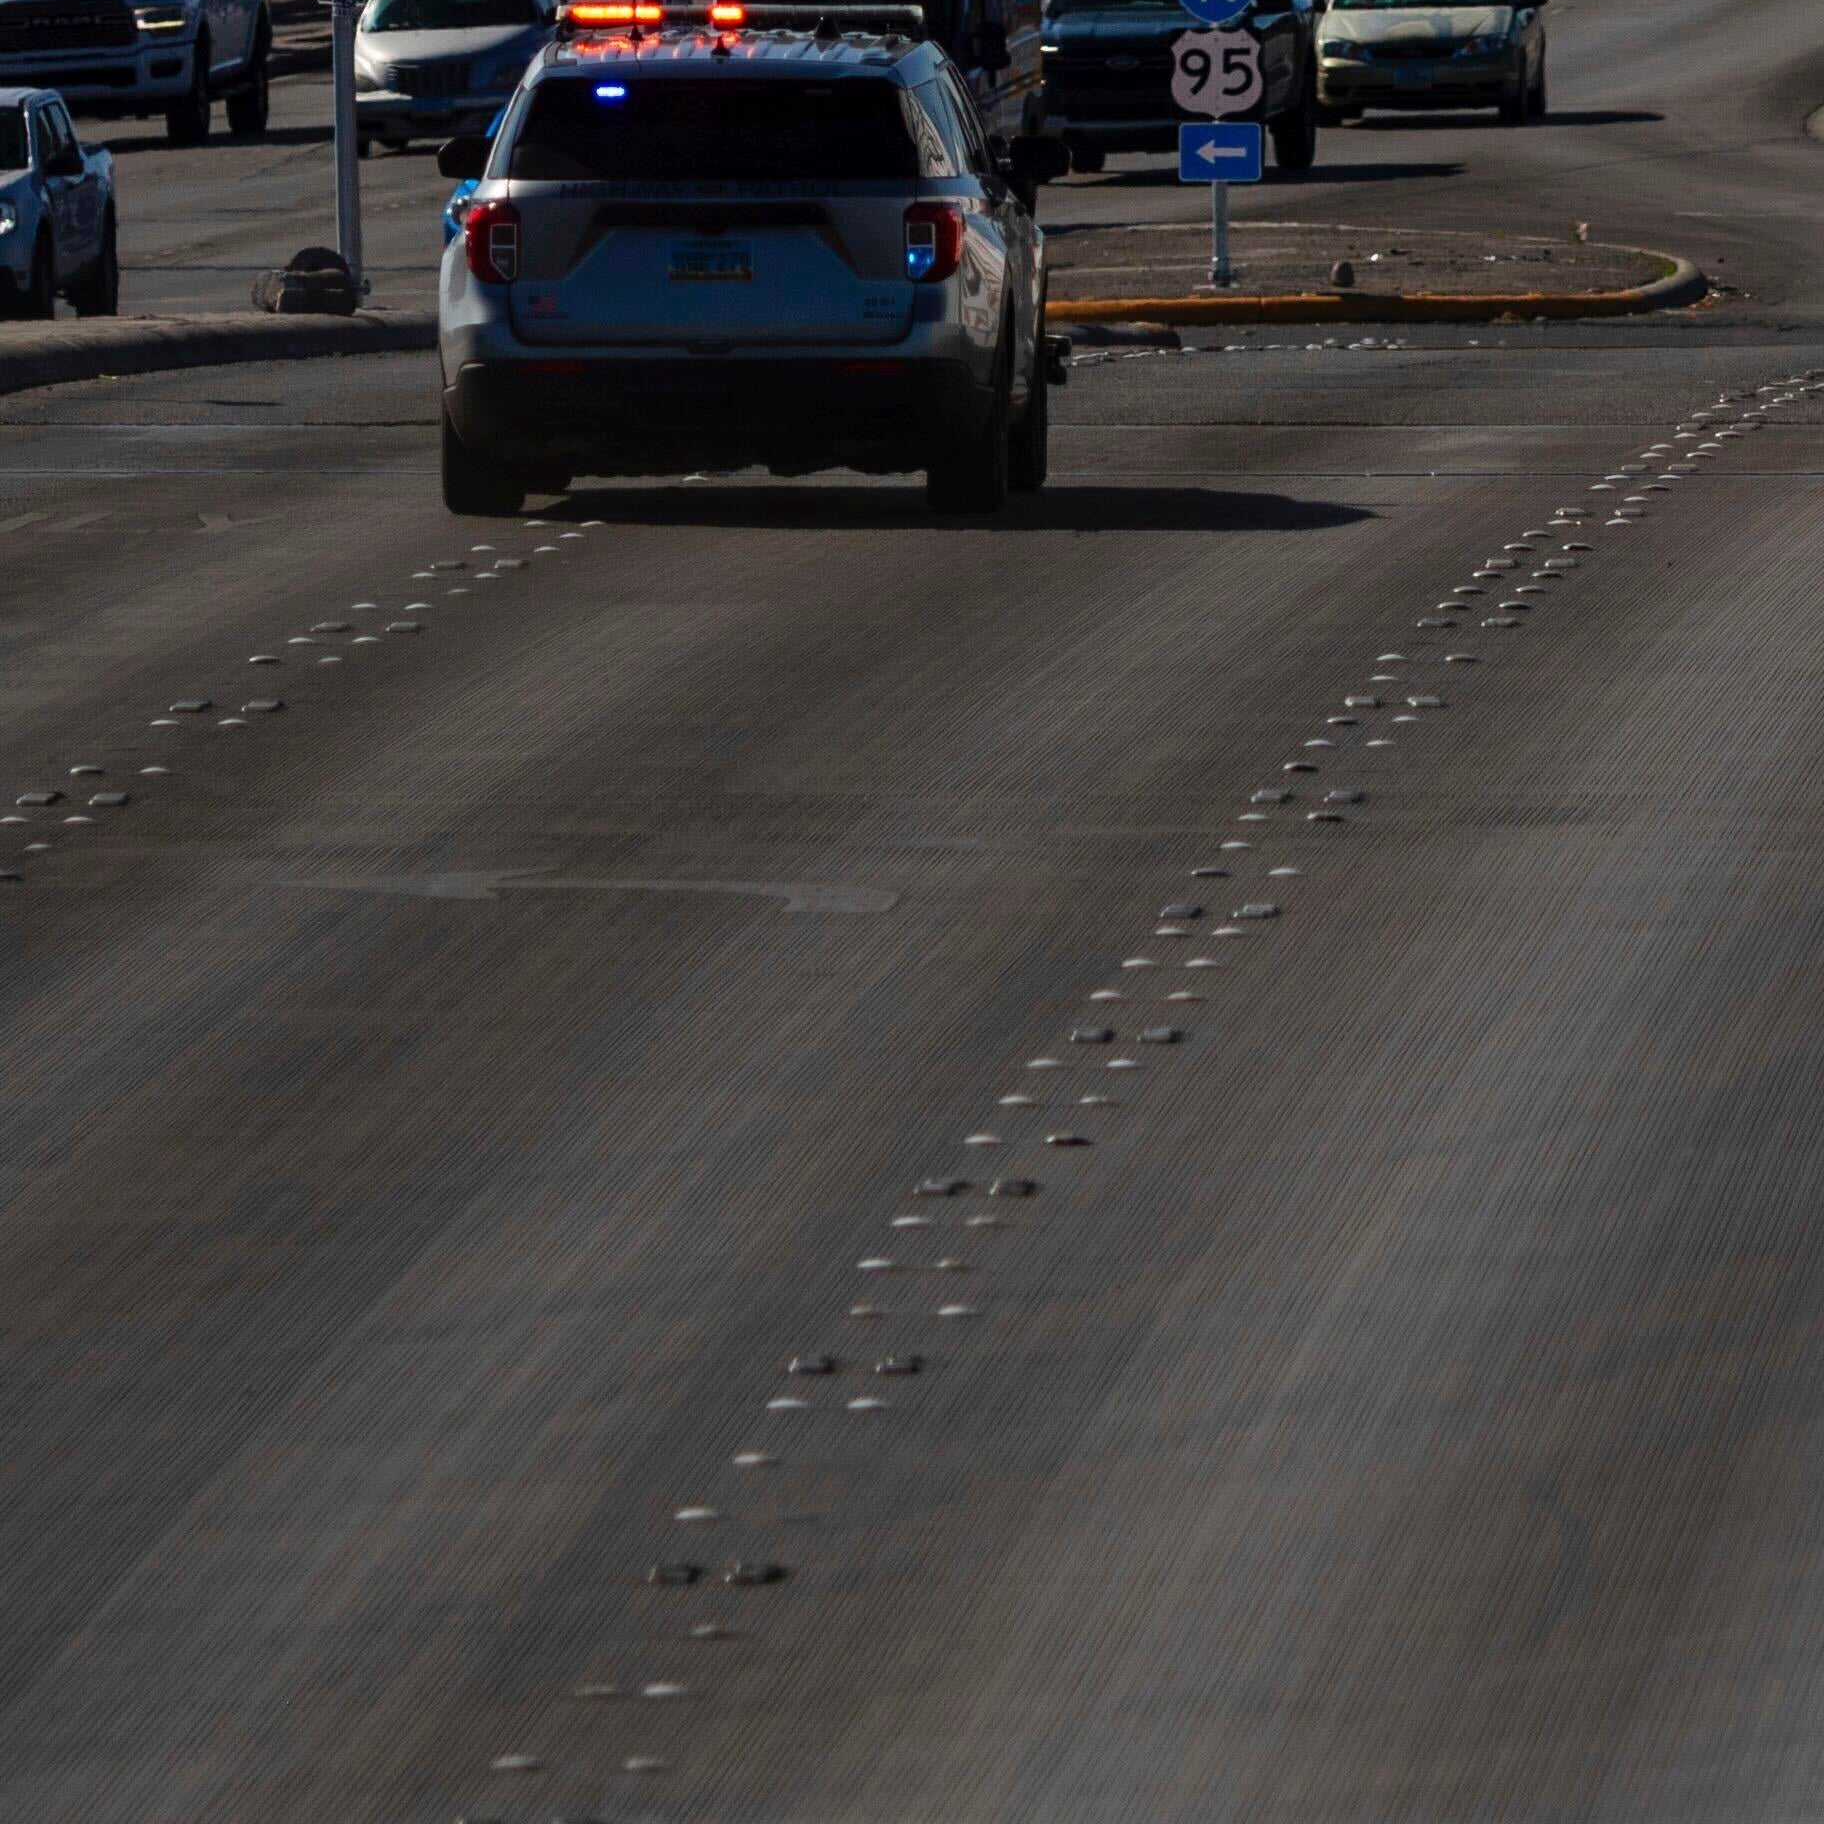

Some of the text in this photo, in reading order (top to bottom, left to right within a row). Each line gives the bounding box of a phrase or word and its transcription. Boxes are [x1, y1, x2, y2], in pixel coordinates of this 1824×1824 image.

[1180, 47, 1253, 96] 95
[560, 182, 842, 199] HIGHWAY PATROL
